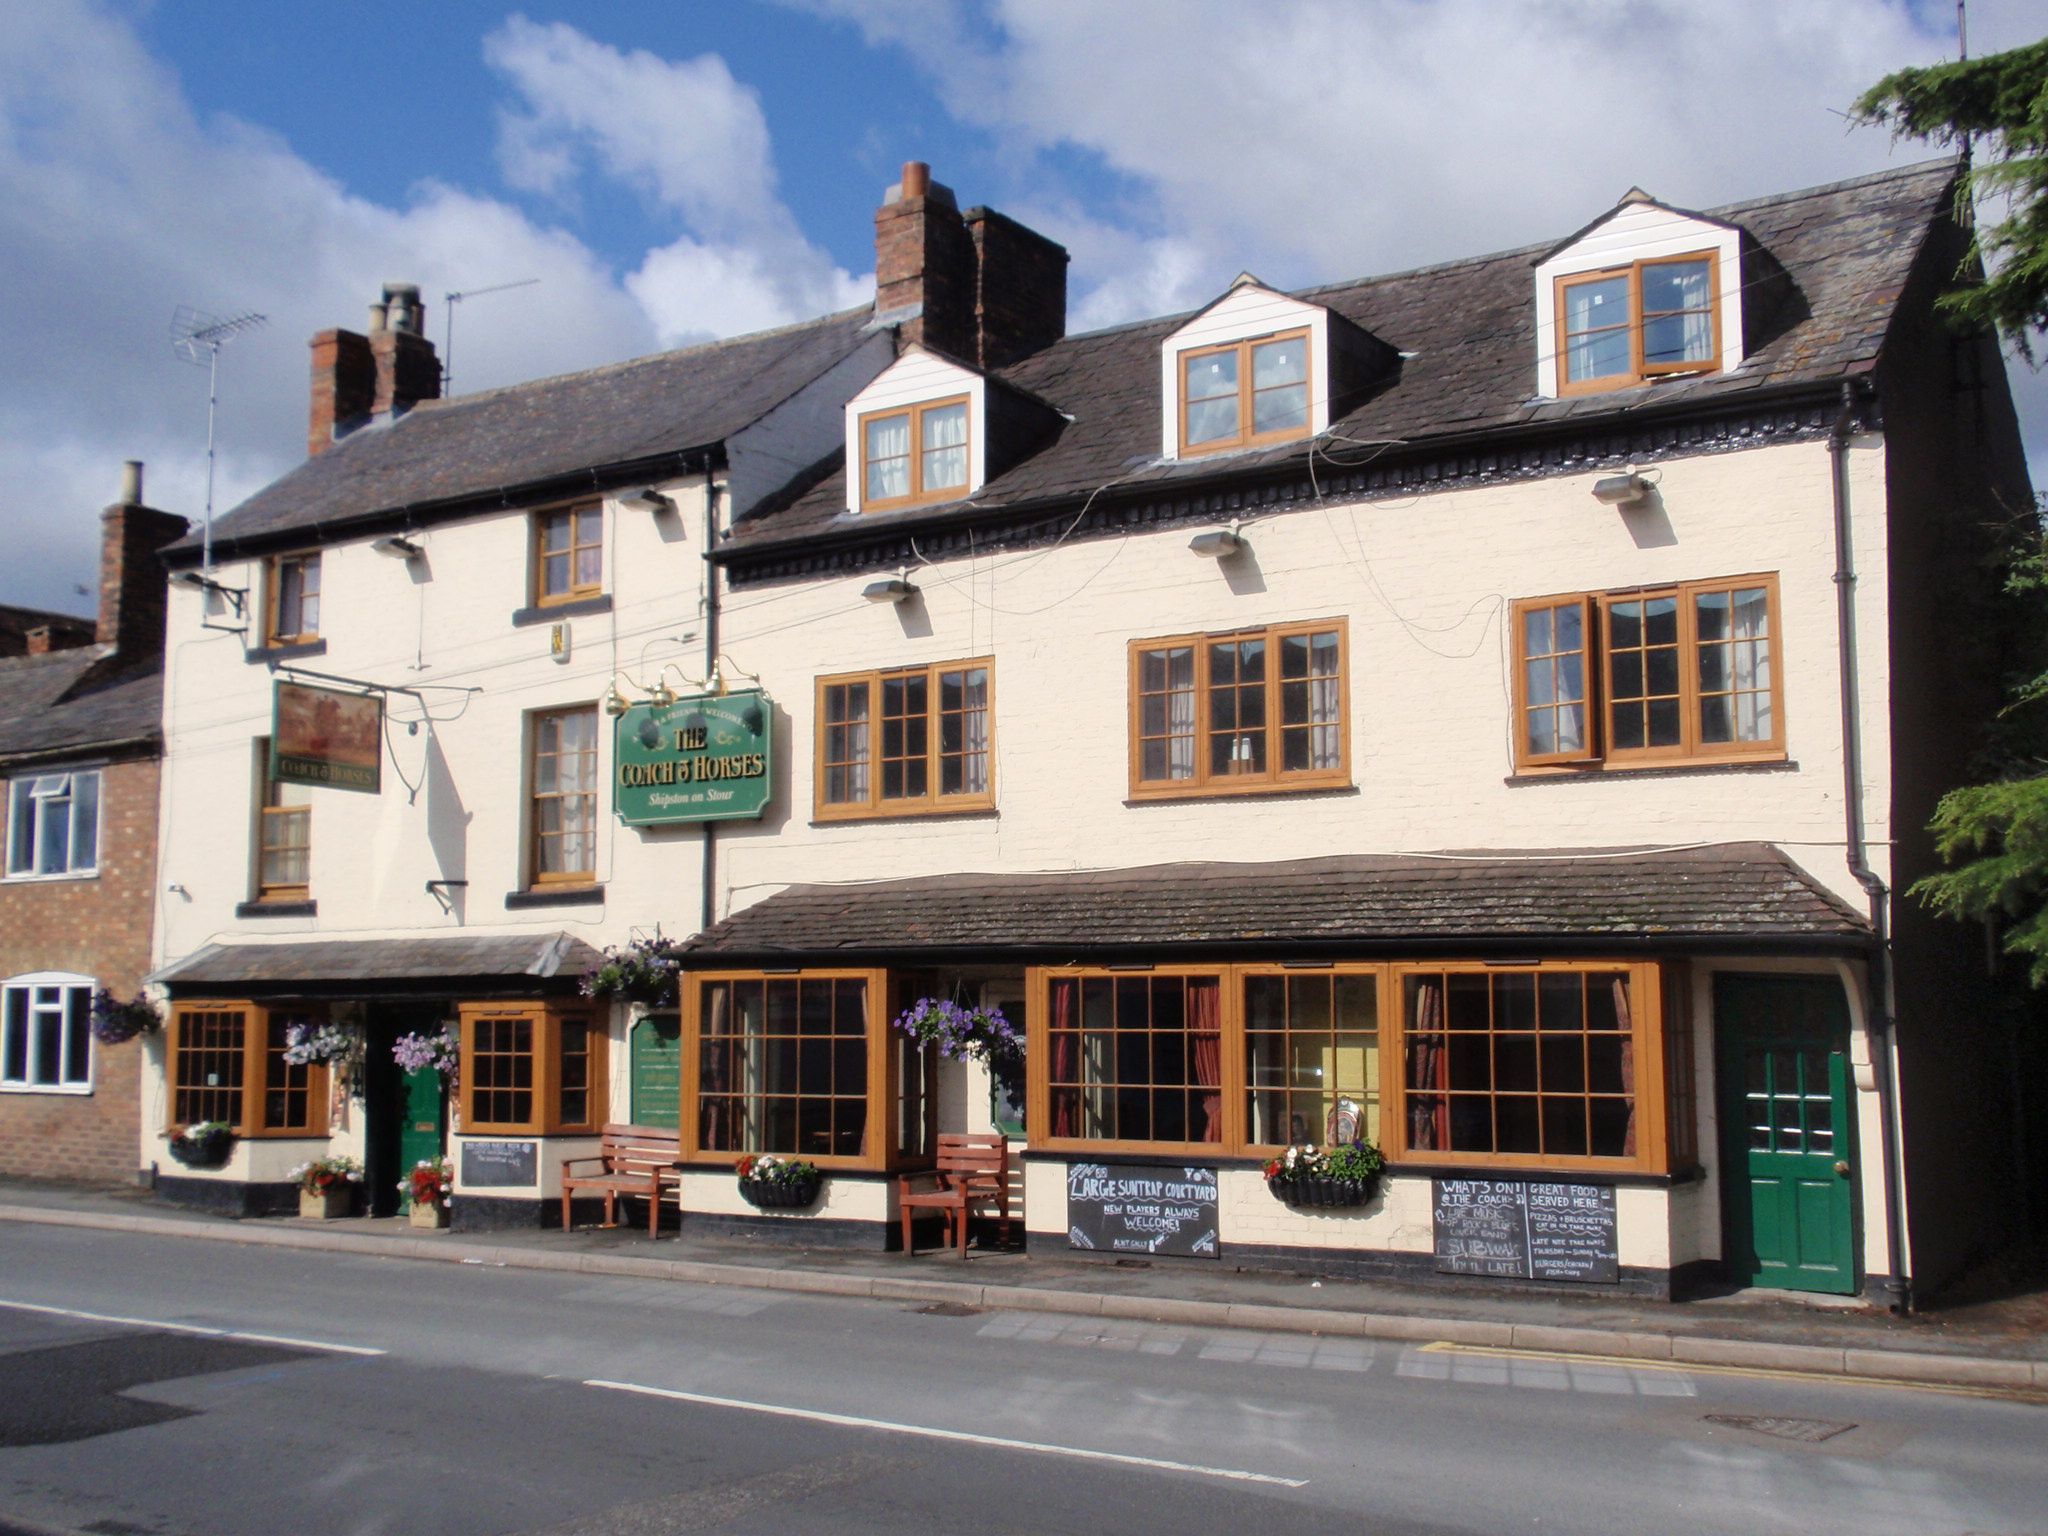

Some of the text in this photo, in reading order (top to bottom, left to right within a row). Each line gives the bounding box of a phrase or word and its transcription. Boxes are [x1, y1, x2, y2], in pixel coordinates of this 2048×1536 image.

[673, 726, 706, 751] THE
[620, 761, 674, 786] COACH
[693, 754, 764, 781] HORSES
[649, 788, 734, 809] Shipston on Stour
[1071, 1178, 1217, 1201] LARGE SUNTRAP COURTYARD
[1441, 1180, 1491, 1194] WHAT'S
[1530, 1183, 1599, 1197] GREAT FOOD
[1452, 1194, 1471, 1204] THE
[1530, 1195, 1599, 1208] SERVED HERE
[1104, 1205, 1200, 1219] NEW PLAYERS ALWAYS
[1529, 1212, 1558, 1222] PIZZAS
[1564, 1215, 1614, 1226] BRUSCHETTAS
[1124, 1217, 1180, 1231] WELCOME!
[1480, 1230, 1507, 1240] BAND
[1533, 1247, 1565, 1256] THURSDAY
[1488, 1262, 1522, 1274] LATE!
